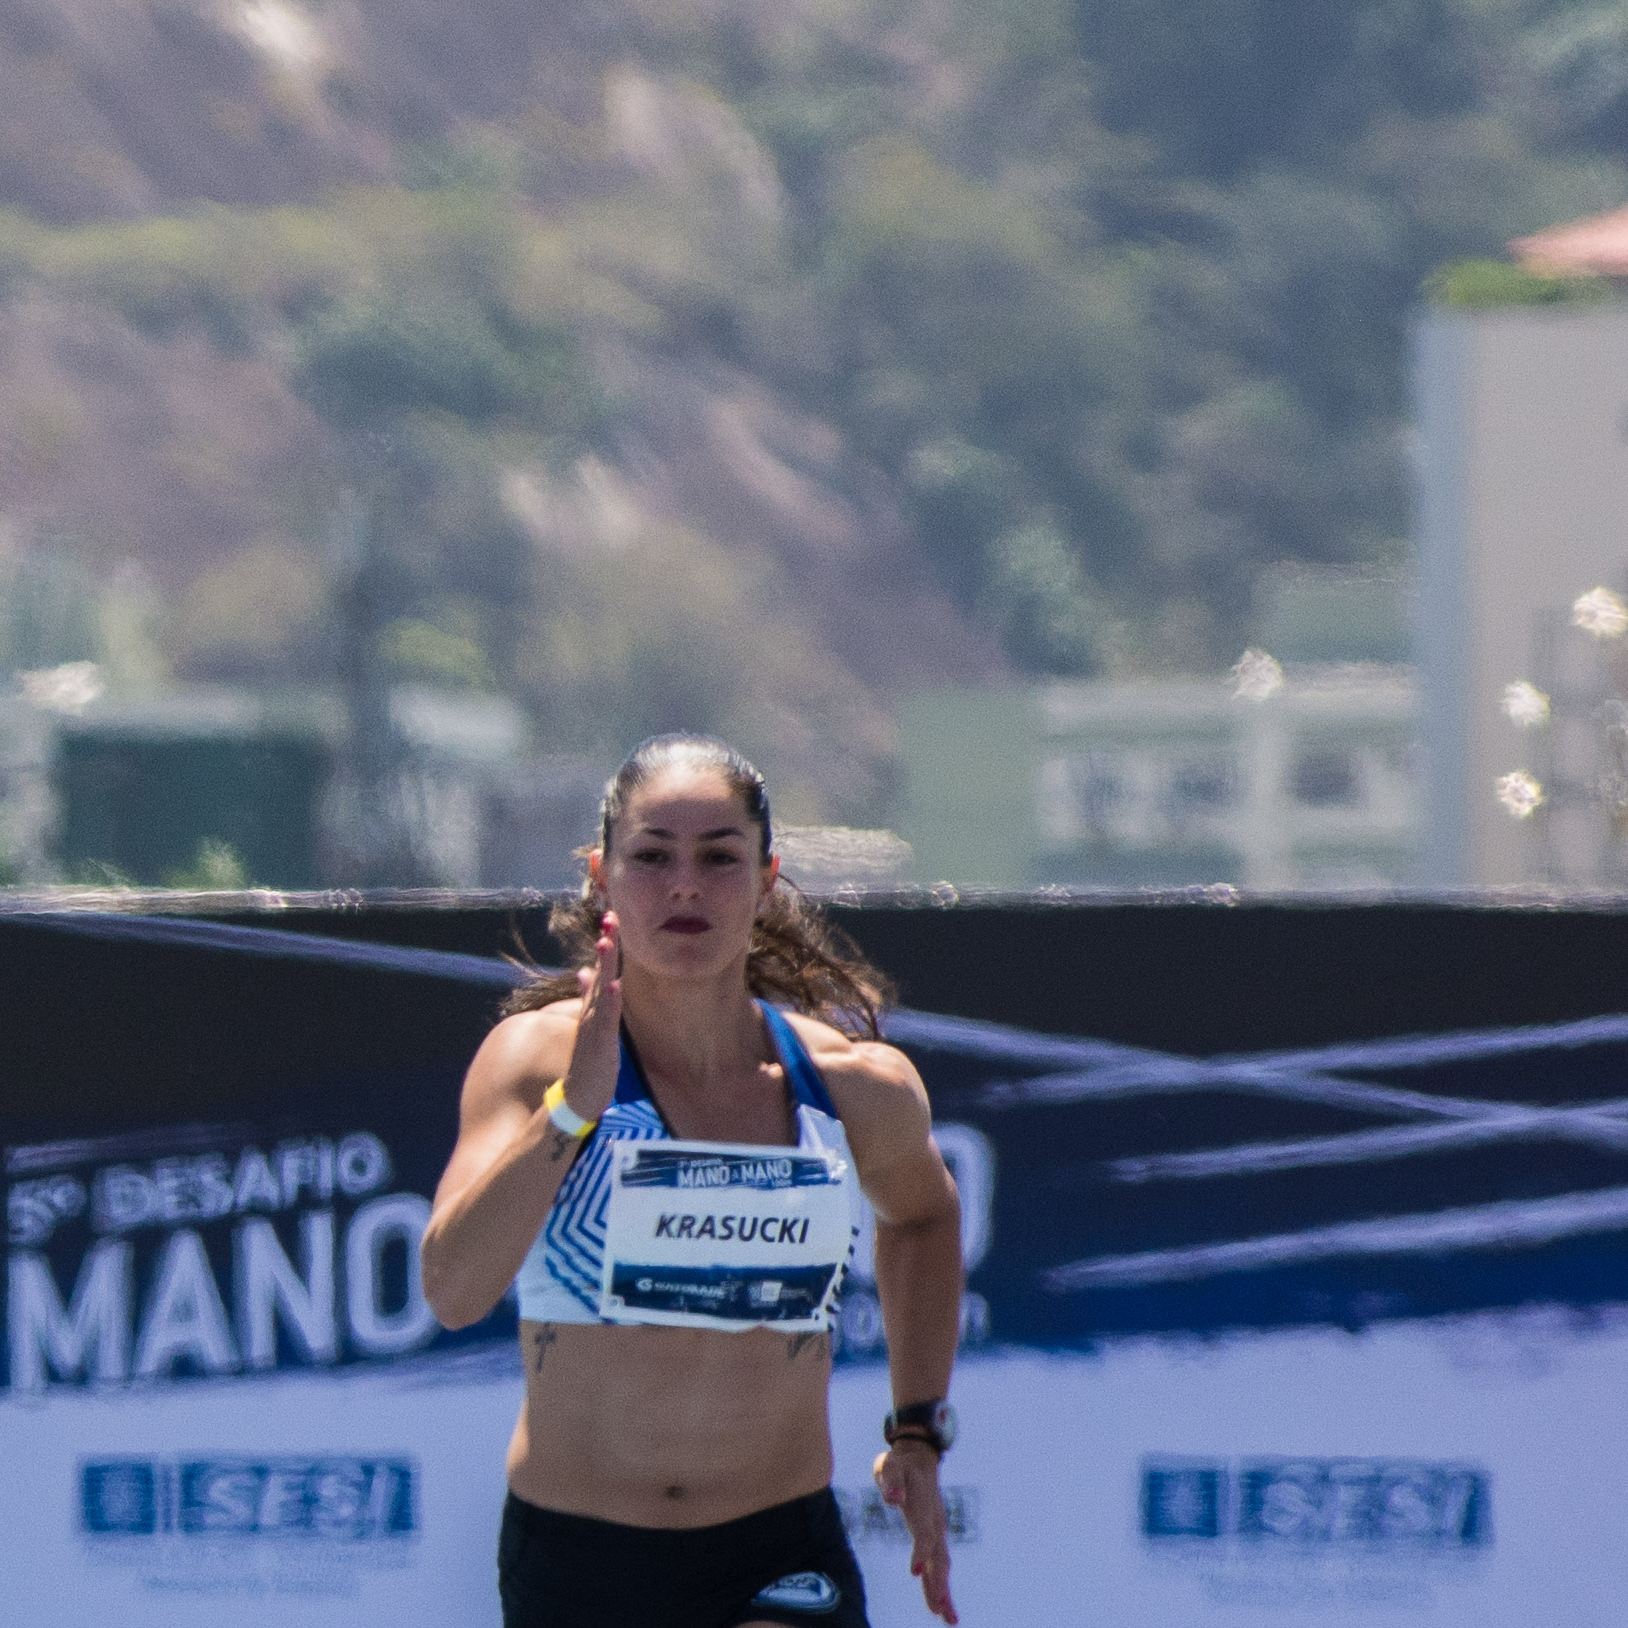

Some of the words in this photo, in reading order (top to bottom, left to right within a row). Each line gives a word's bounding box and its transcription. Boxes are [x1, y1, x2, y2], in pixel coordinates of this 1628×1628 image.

[93, 1131, 391, 1234] DESAFIO
[677, 1164, 730, 1188] MANO
[741, 1157, 793, 1183] MANO
[654, 1214, 810, 1244] KRASUCKI
[6, 1192, 440, 1395] MANO
